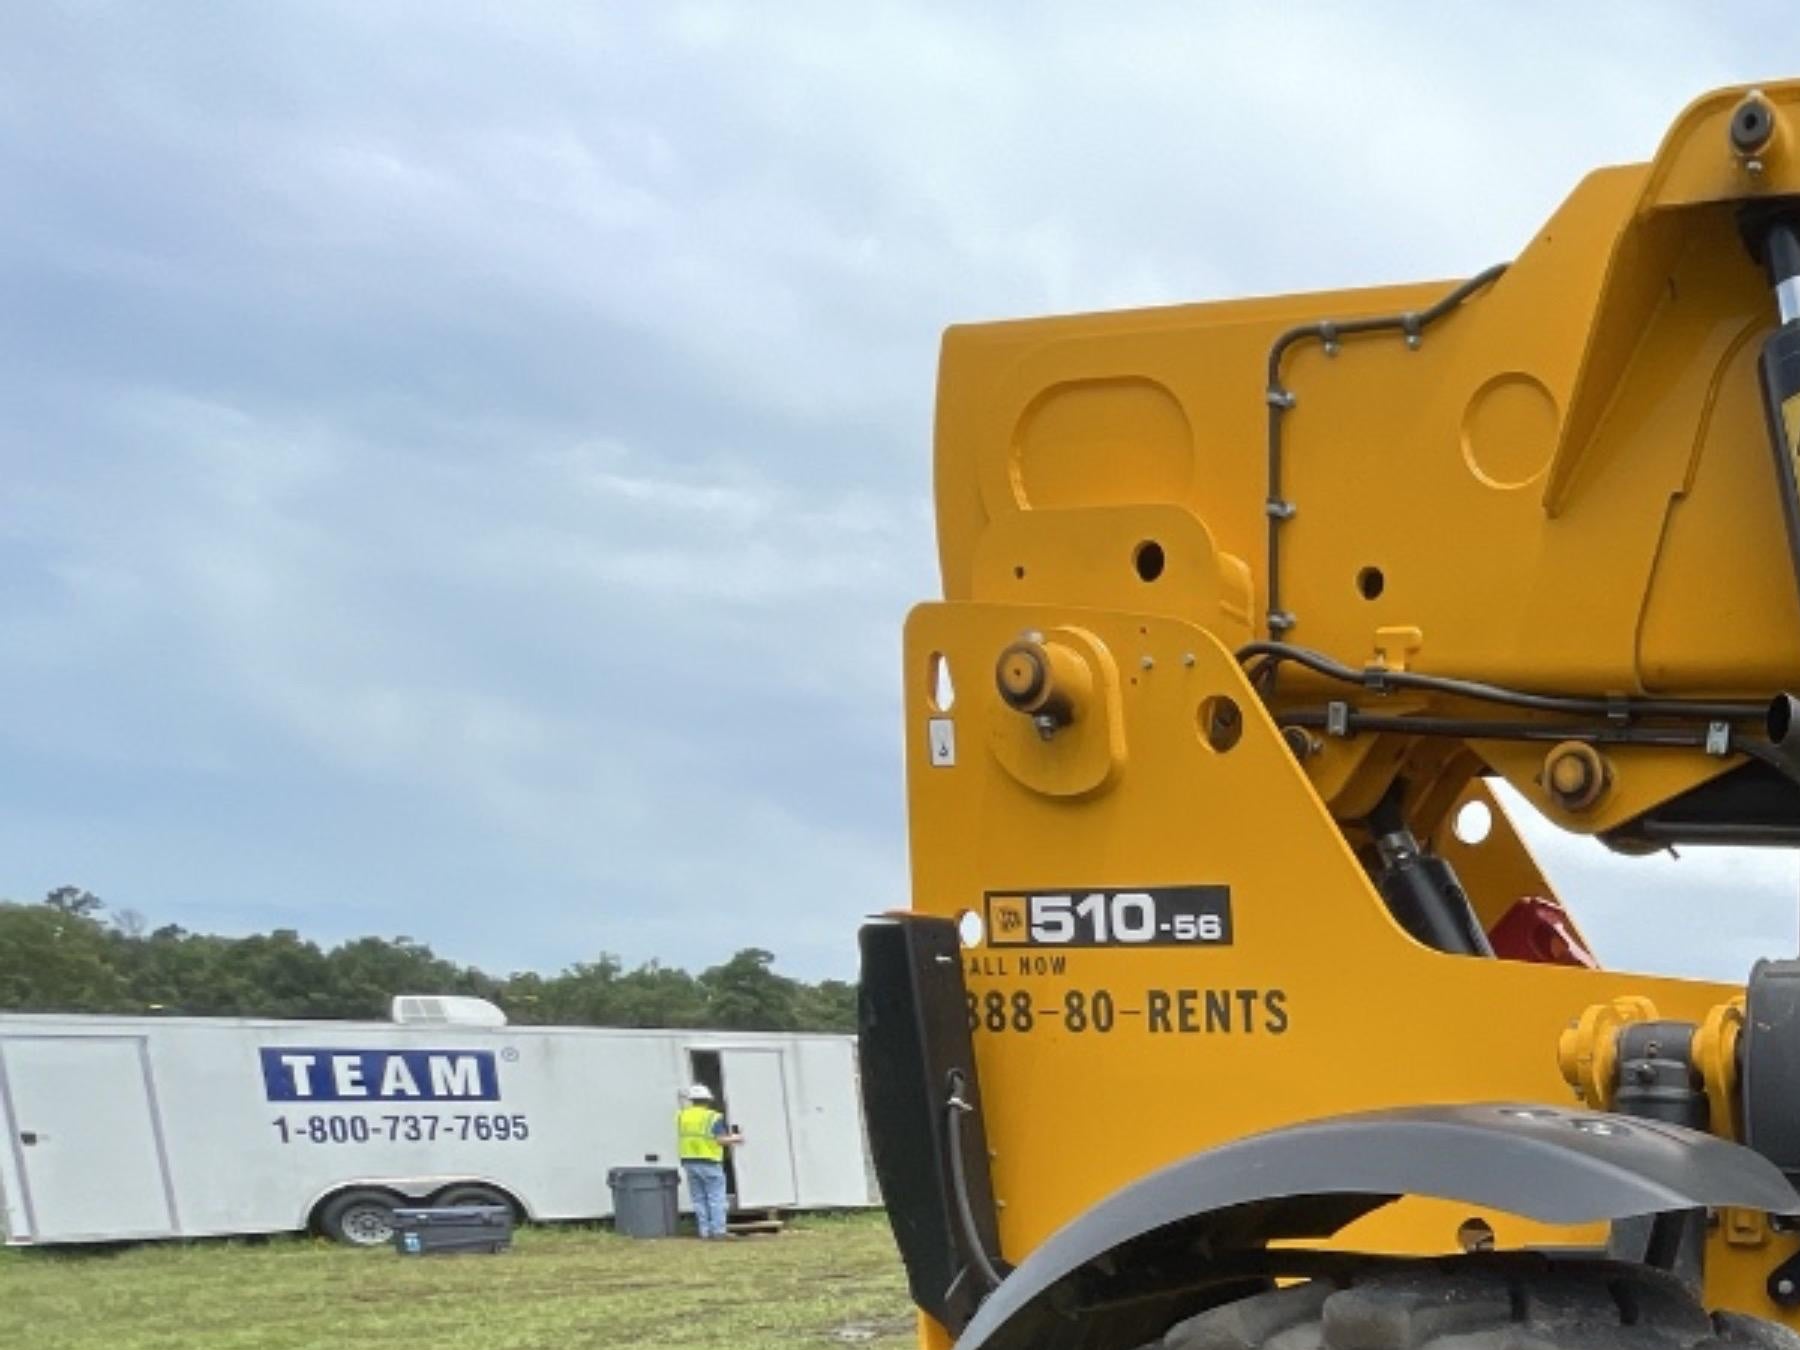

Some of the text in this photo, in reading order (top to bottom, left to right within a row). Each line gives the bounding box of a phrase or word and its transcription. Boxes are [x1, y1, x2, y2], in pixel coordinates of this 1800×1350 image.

[1031, 893, 1223, 944] 510-56
[962, 955, 1066, 976] ALL NOW
[281, 1055, 484, 1097] TEAM
[271, 1114, 530, 1144] 1-800-737-7695
